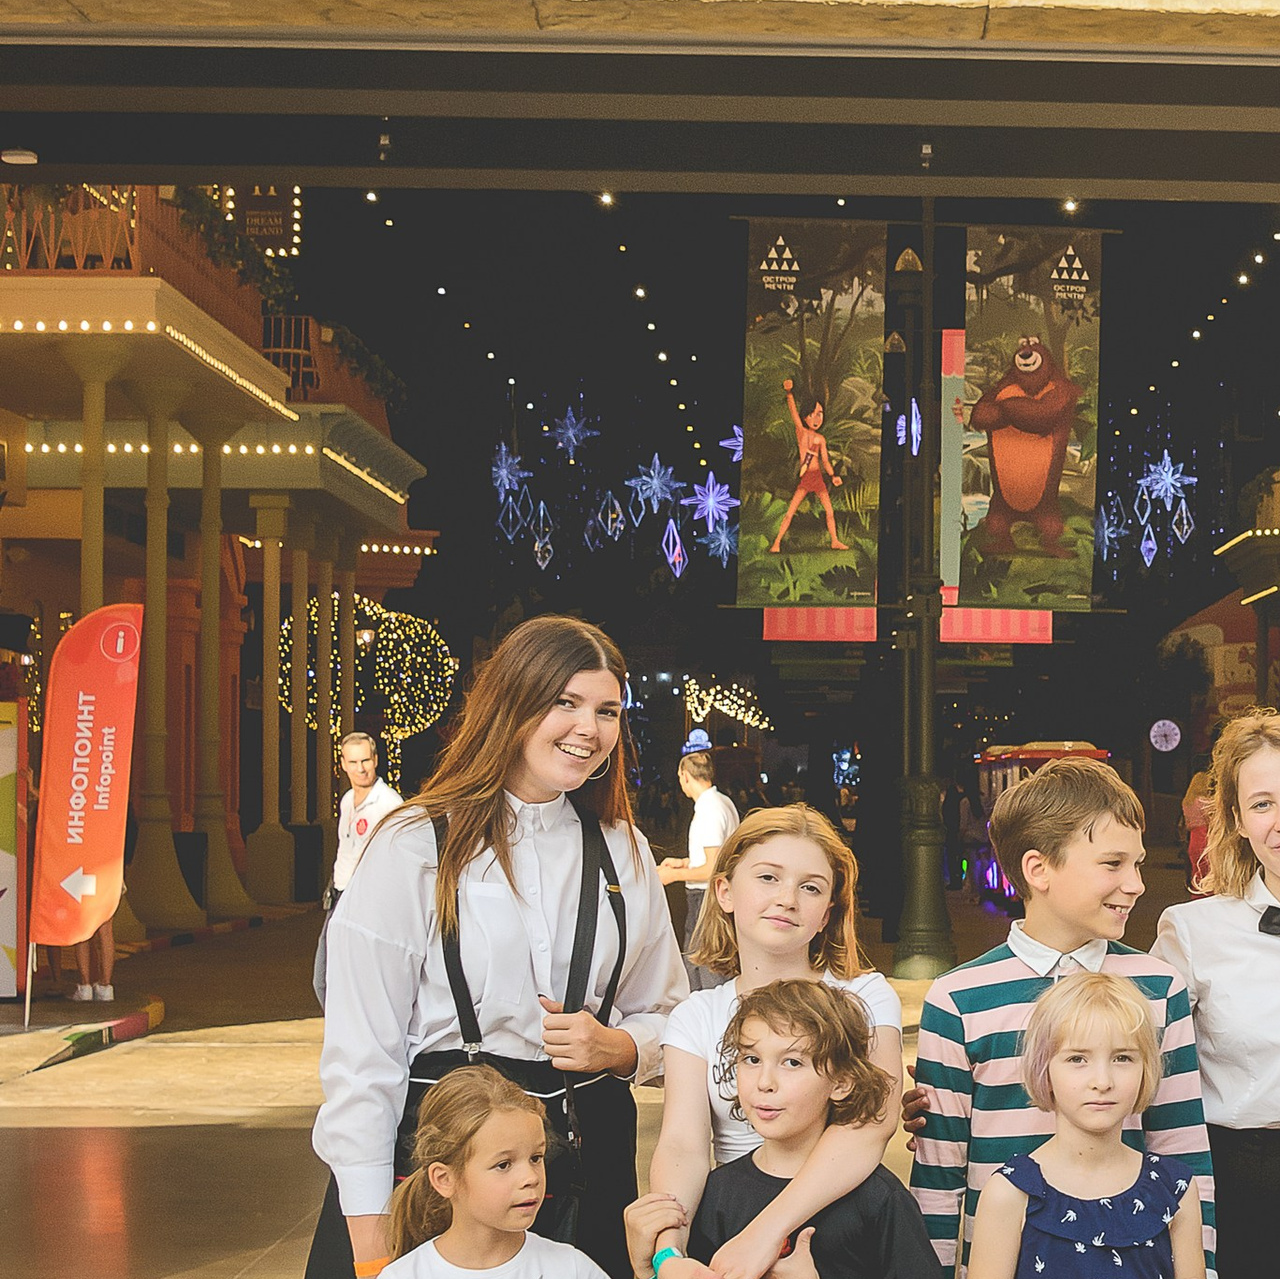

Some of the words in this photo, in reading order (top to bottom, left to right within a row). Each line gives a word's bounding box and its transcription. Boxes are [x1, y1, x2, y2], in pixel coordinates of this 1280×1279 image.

[762, 275, 797, 283] ОСТРОВ
[1053, 284, 1086, 292] ОСТРОВ
[67, 690, 97, 844] ИНФОПОИНТ
[93, 726, 117, 811] Infopoint
